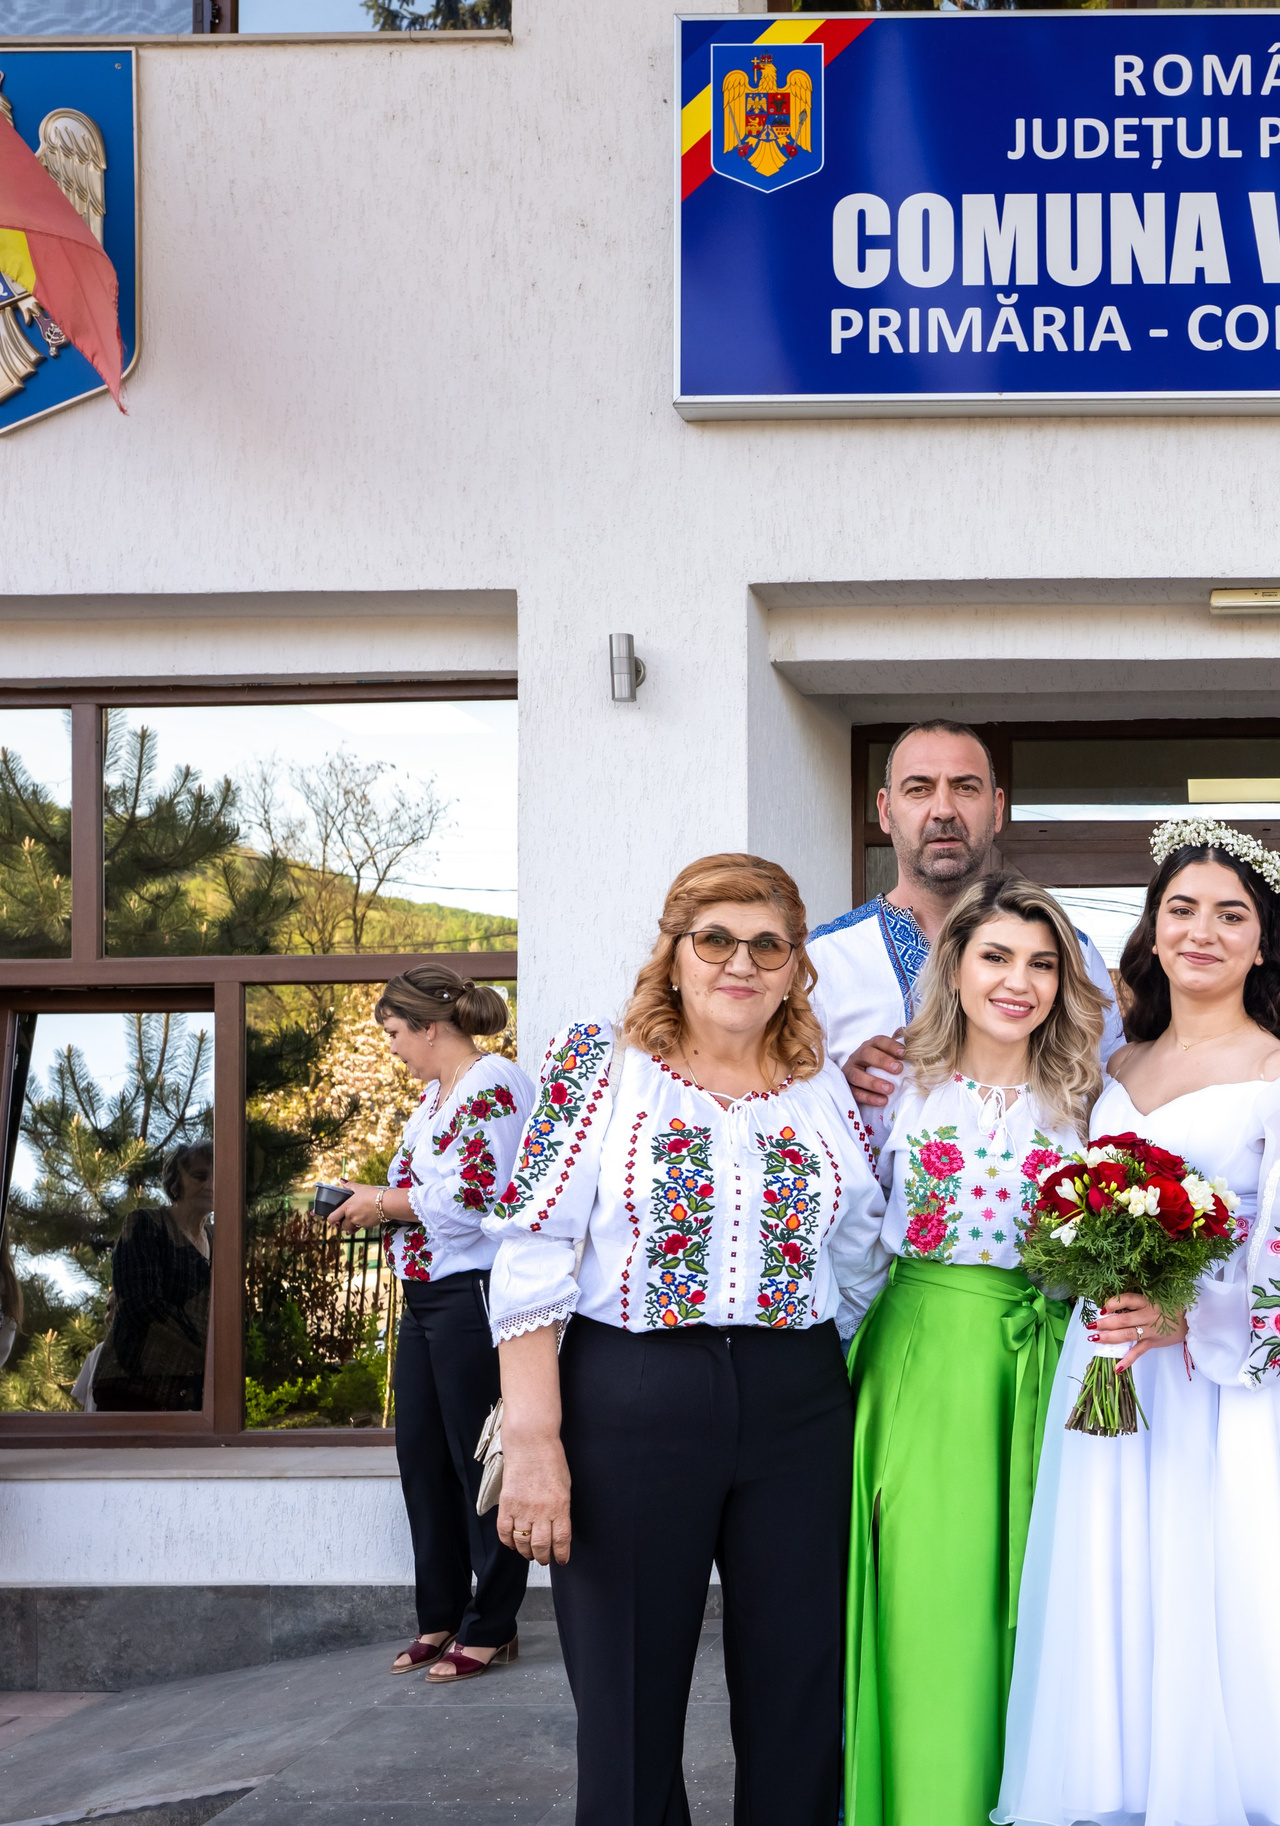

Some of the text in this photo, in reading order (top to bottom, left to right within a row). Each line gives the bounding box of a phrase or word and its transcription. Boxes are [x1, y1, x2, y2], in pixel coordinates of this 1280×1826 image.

[1007, 117, 1243, 170] JUDEȚUL
[831, 191, 1233, 289] COMUNA
[830, 293, 1133, 355] PRIMĂRIA
[1149, 327, 1170, 339] -
